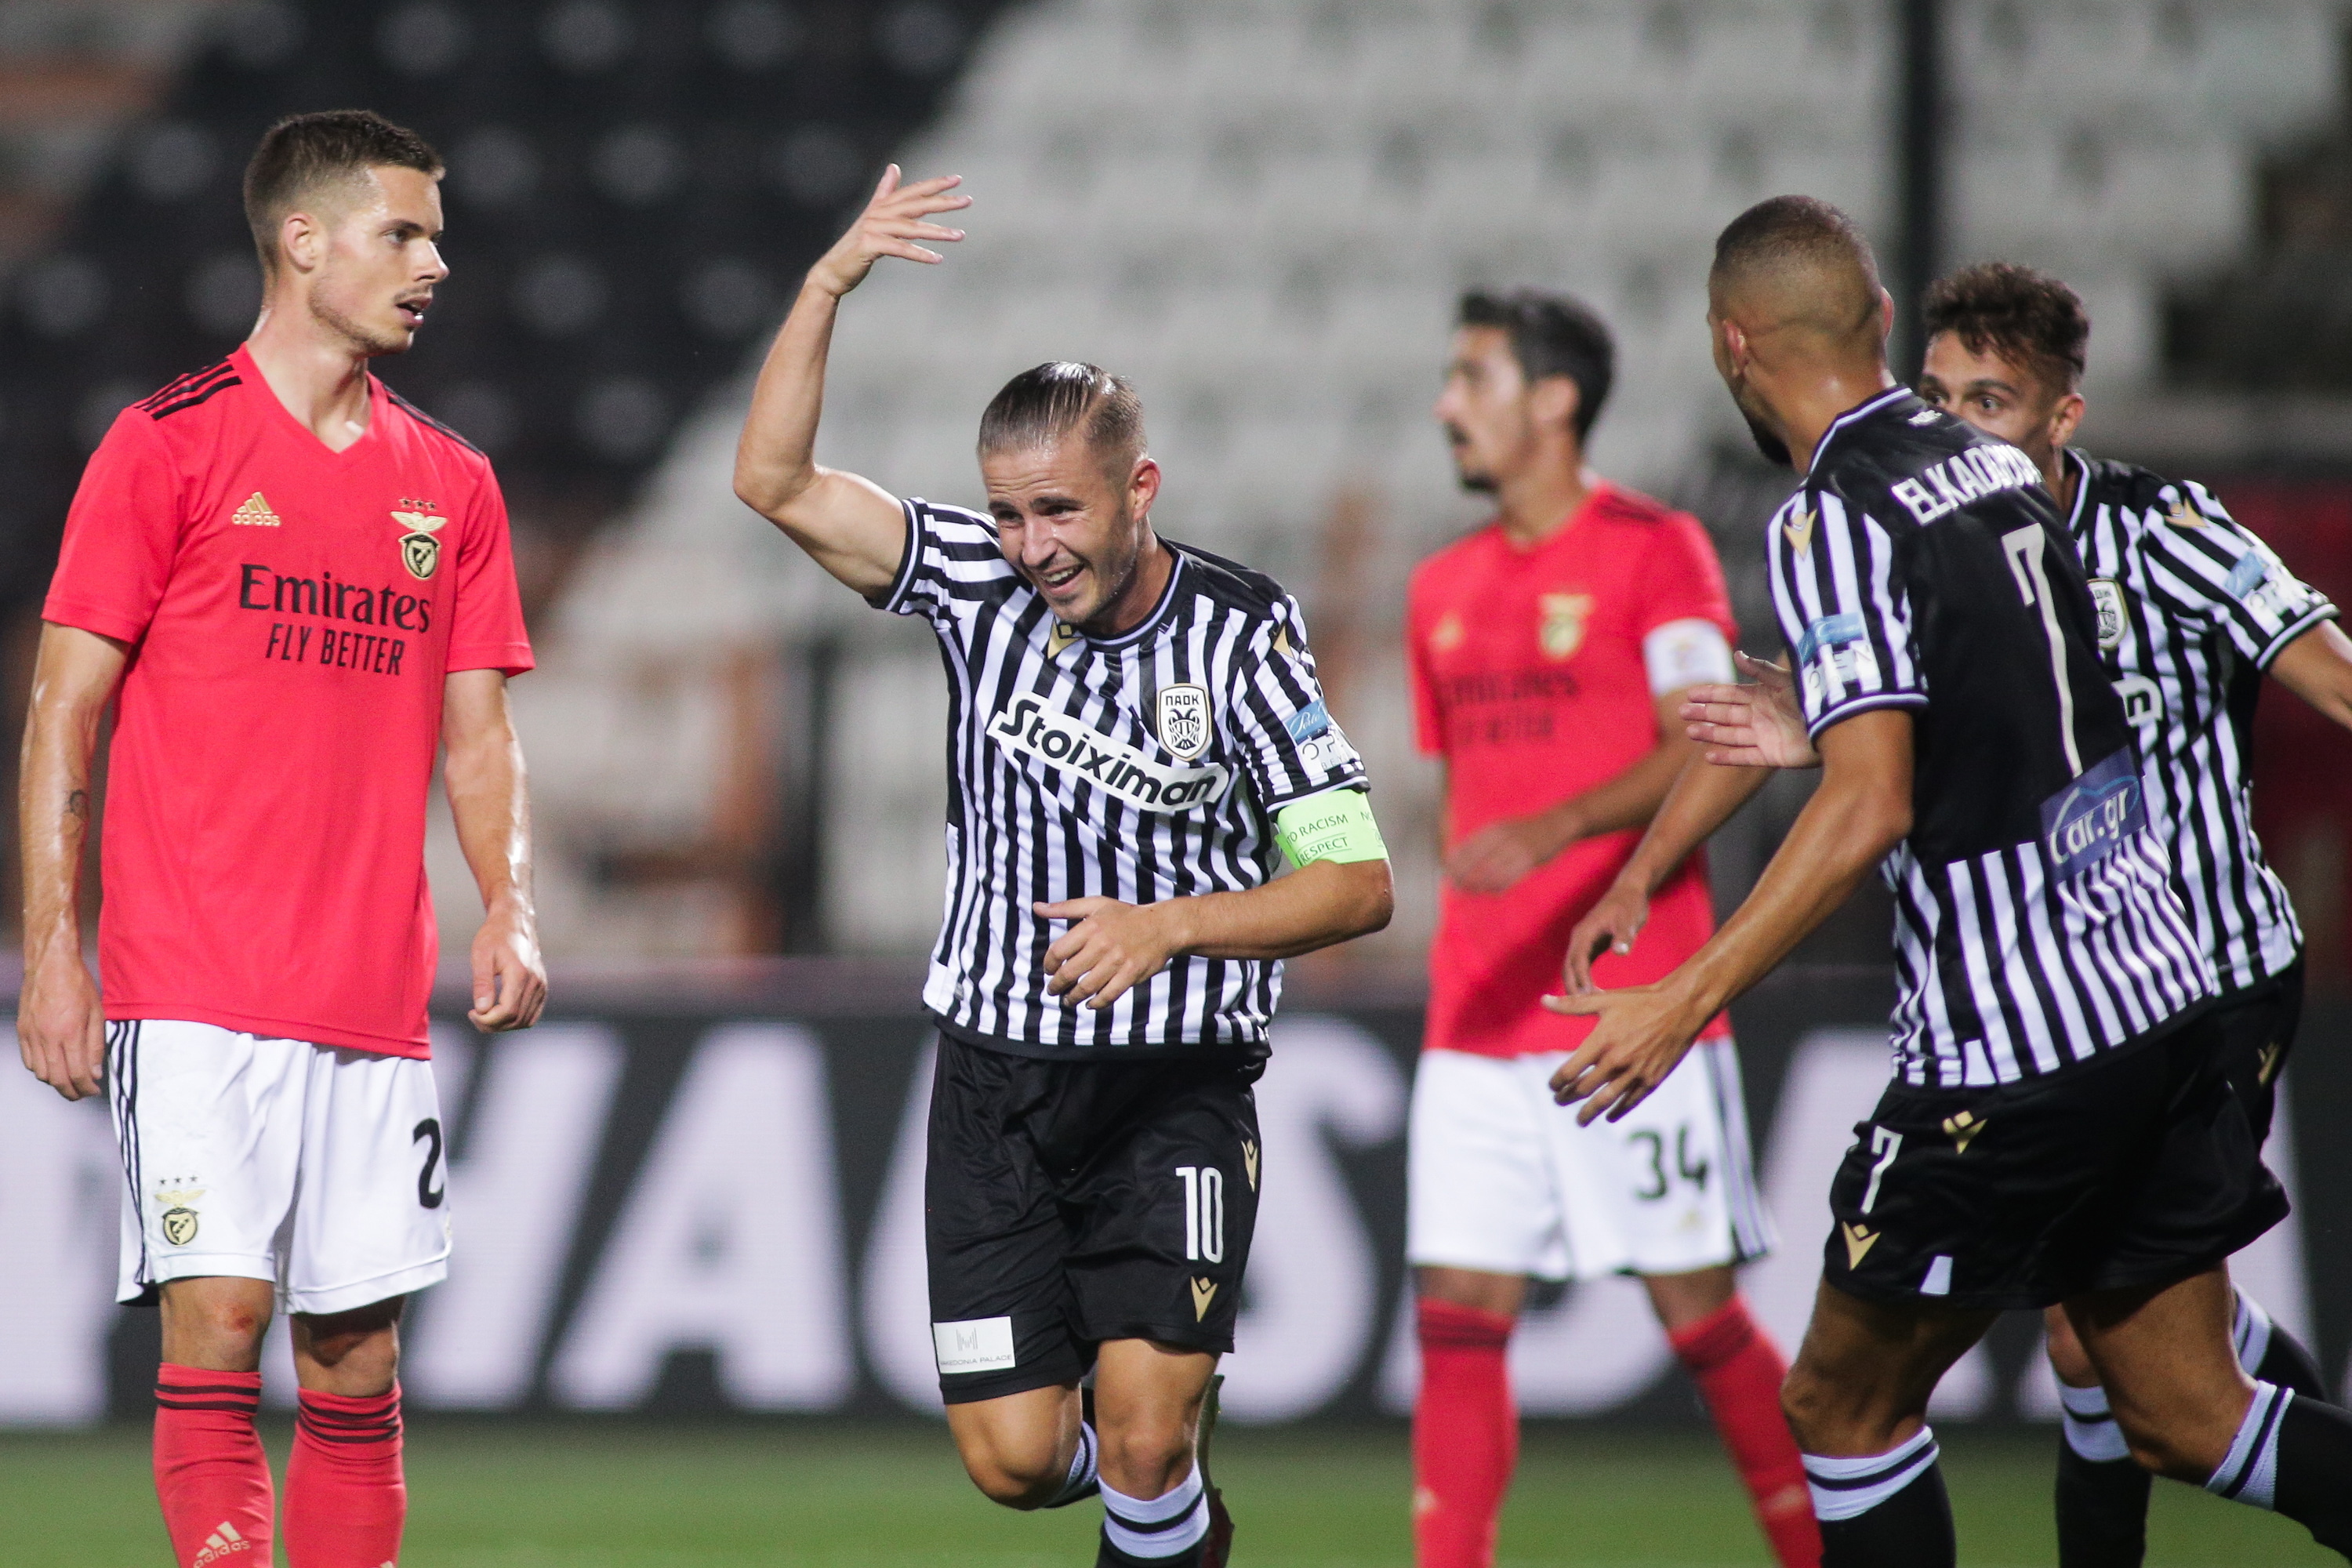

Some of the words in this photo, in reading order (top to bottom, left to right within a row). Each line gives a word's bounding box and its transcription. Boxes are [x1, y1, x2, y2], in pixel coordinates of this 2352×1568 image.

[231, 514, 281, 527] adidas
[239, 563, 430, 633] Emirates
[265, 622, 312, 662] FLY
[319, 628, 405, 676] BETTER
[2001, 522, 2083, 778] 7
[998, 699, 1218, 805] Stoiximan
[1298, 837, 1348, 865] RESPECT
[1299, 814, 1348, 837] RACISM
[1627, 1126, 1708, 1201] 34
[1861, 1126, 1903, 1214] 7
[1176, 1166, 1224, 1264] 10
[979, 1354, 1012, 1363] PALACE
[193, 1539, 251, 1568] adidas
